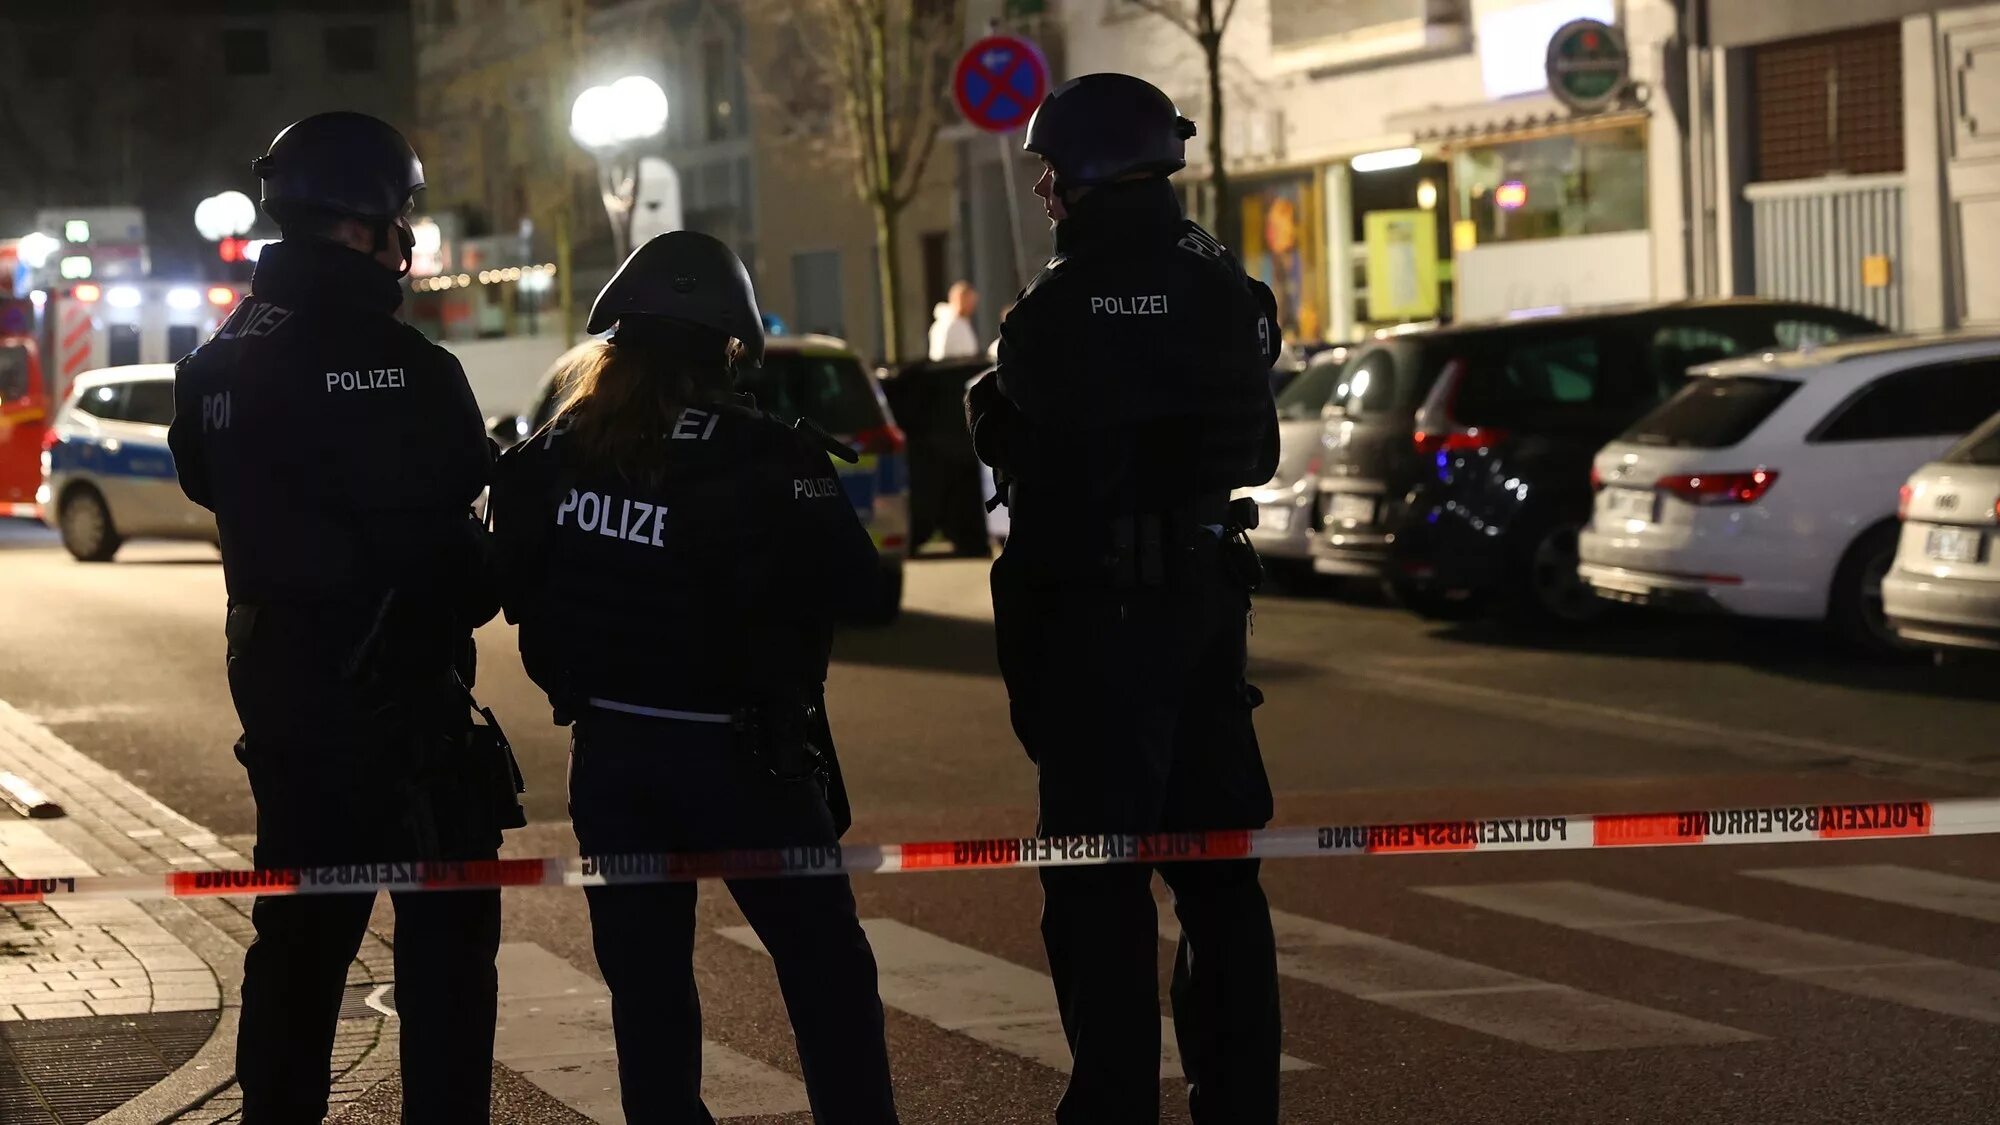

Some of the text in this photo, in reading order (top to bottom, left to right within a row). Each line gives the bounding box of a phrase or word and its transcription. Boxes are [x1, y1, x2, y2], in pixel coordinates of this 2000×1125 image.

[1091, 294, 1168, 315] POLIZEI
[326, 367, 405, 393] POLIZEI
[793, 477, 838, 500] POLIZEI
